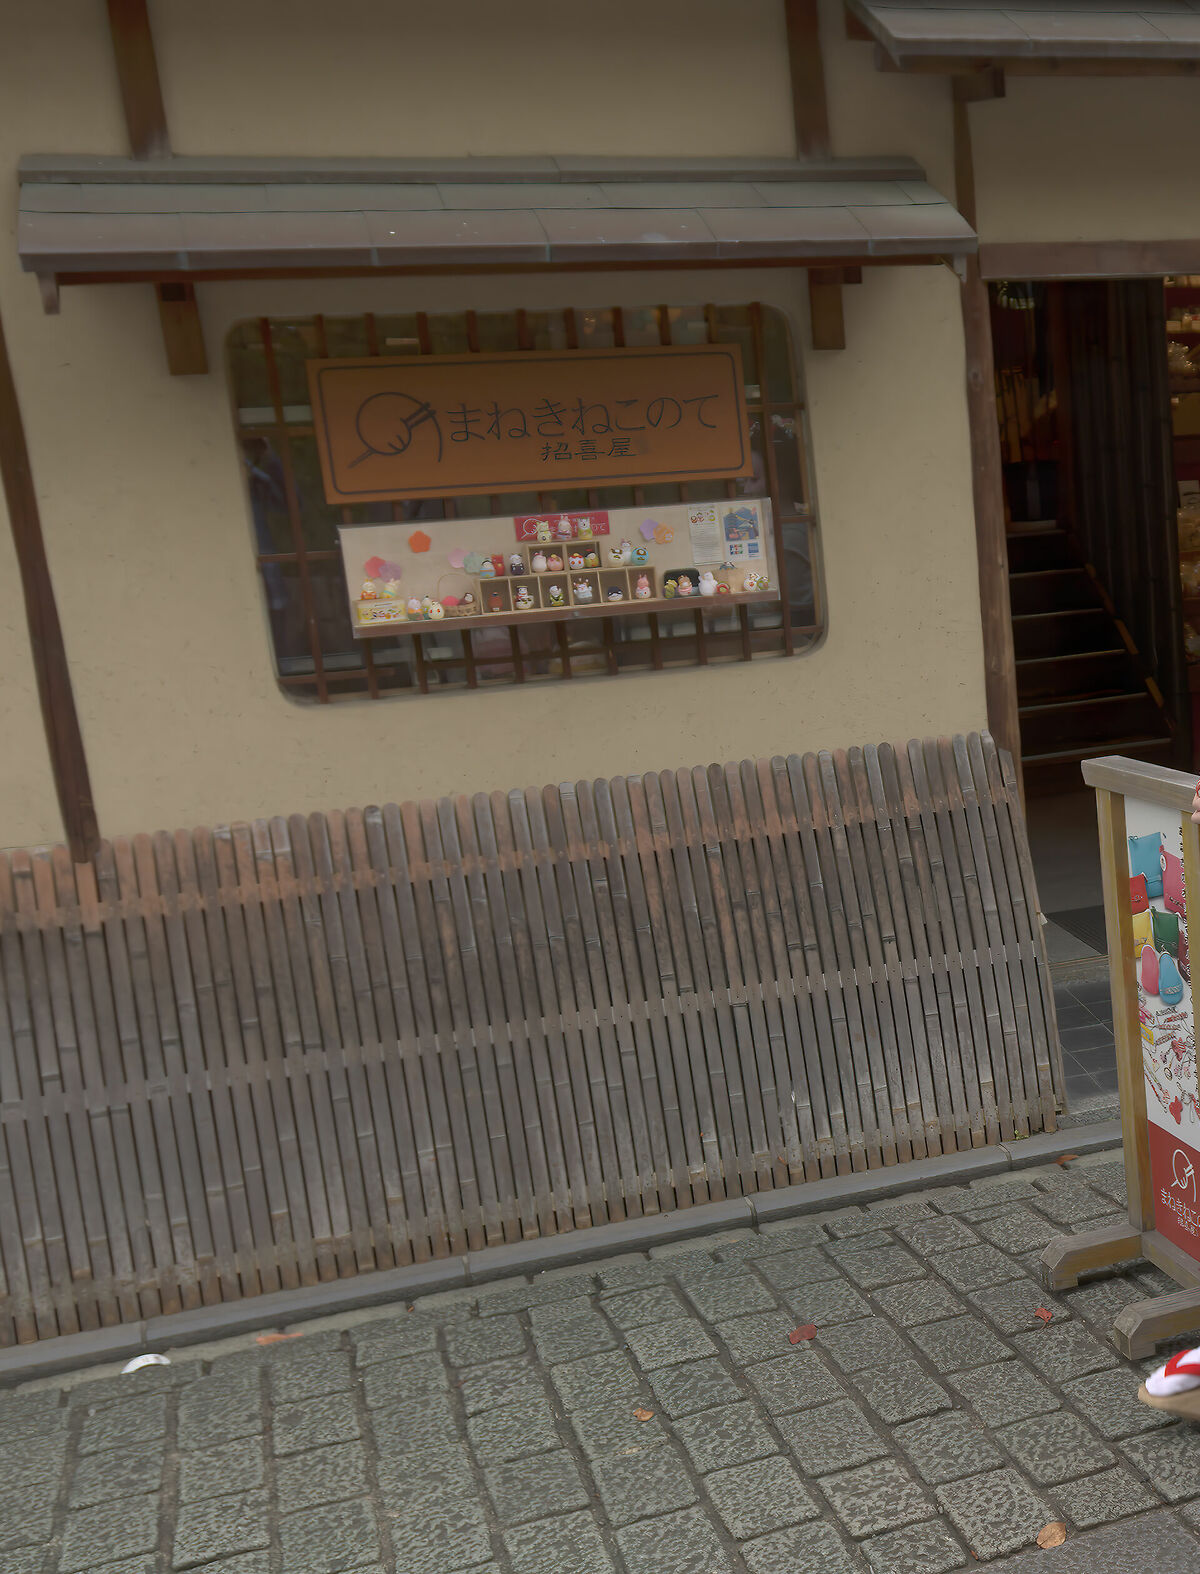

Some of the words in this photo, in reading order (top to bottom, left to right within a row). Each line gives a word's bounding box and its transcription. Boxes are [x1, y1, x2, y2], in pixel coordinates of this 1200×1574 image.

[447, 395, 719, 442] まねきねこのて
[540, 438, 637, 462] 招喜屋
